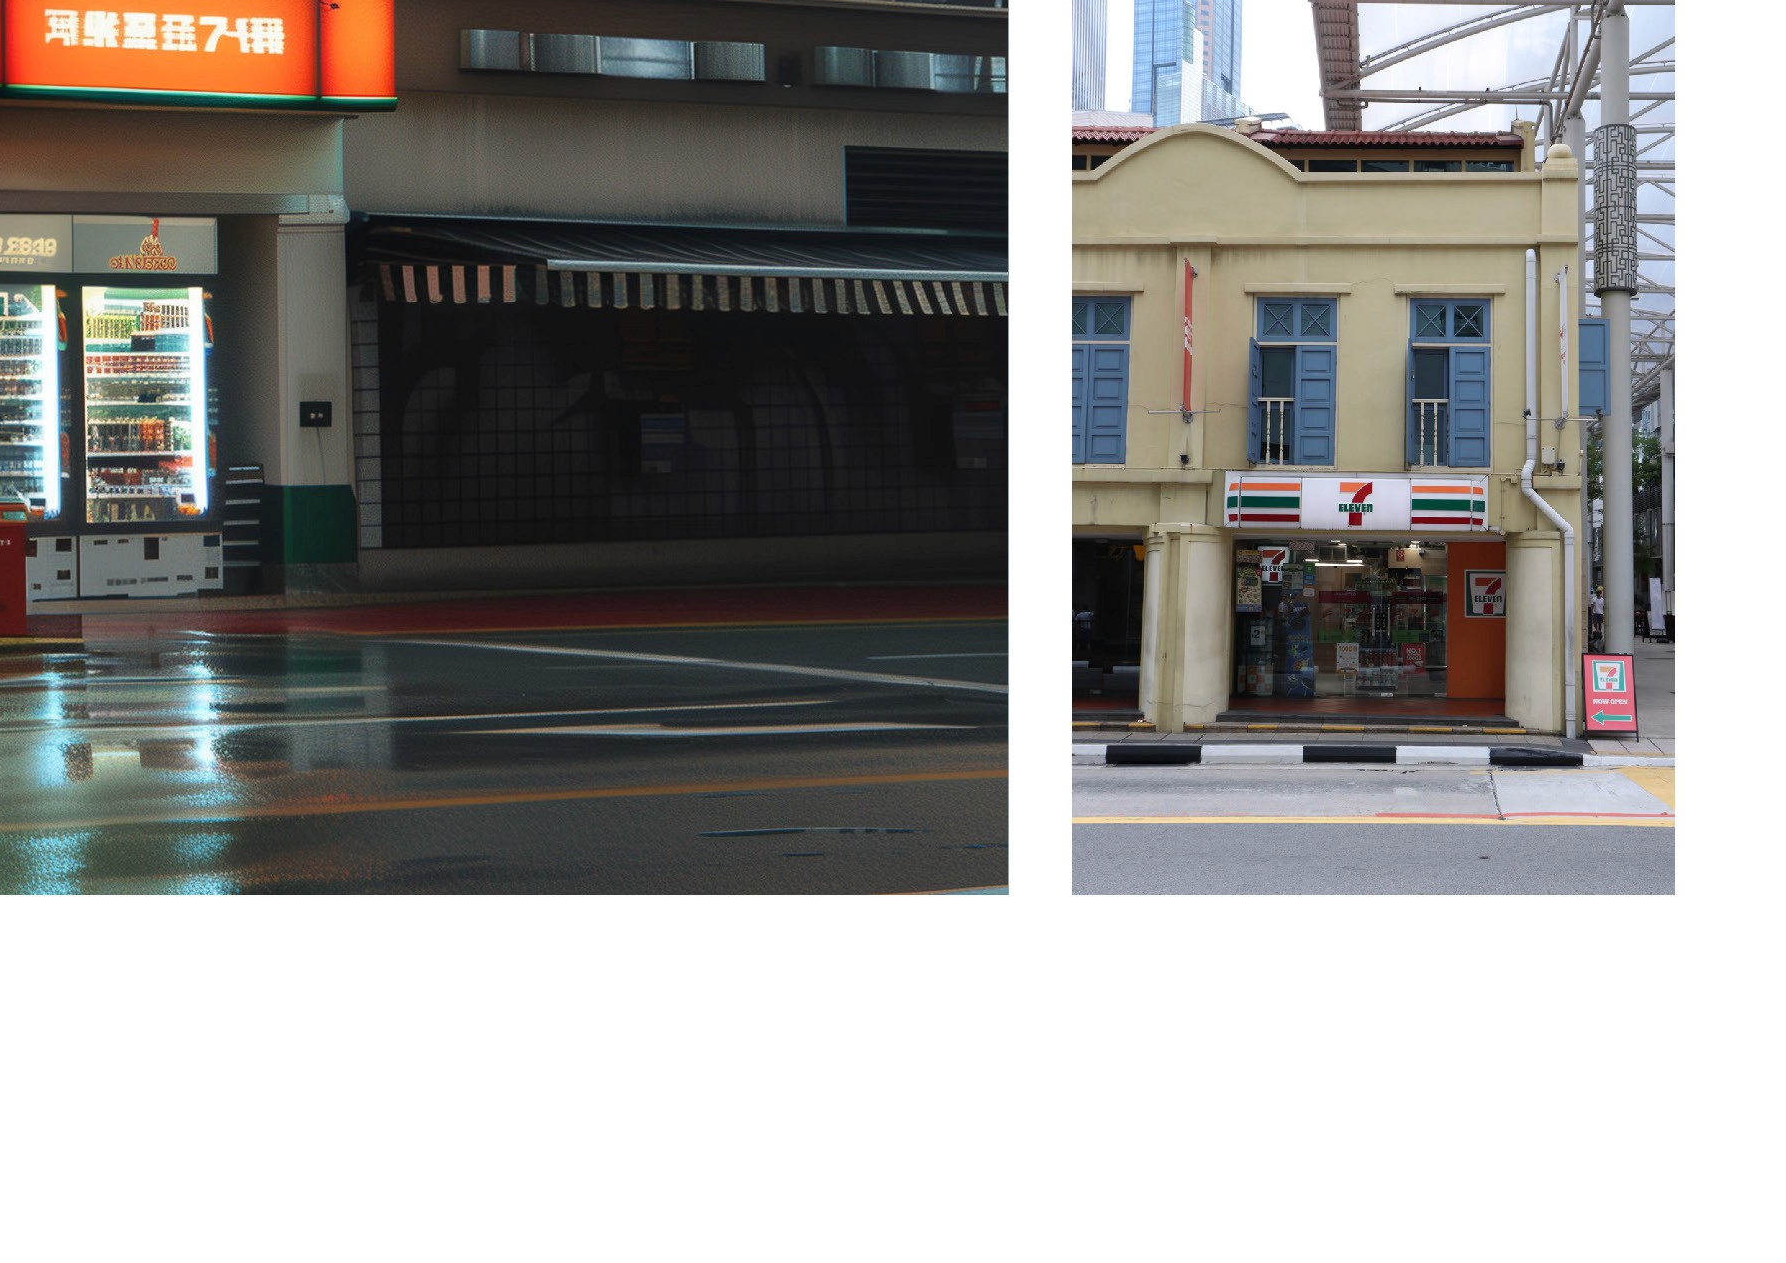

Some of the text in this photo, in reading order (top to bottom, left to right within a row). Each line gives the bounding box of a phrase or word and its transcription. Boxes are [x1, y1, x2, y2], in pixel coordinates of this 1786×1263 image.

[1338, 481, 1373, 526] 7 ELEVEN
[1474, 577, 1502, 615] 7 ELEVEN
